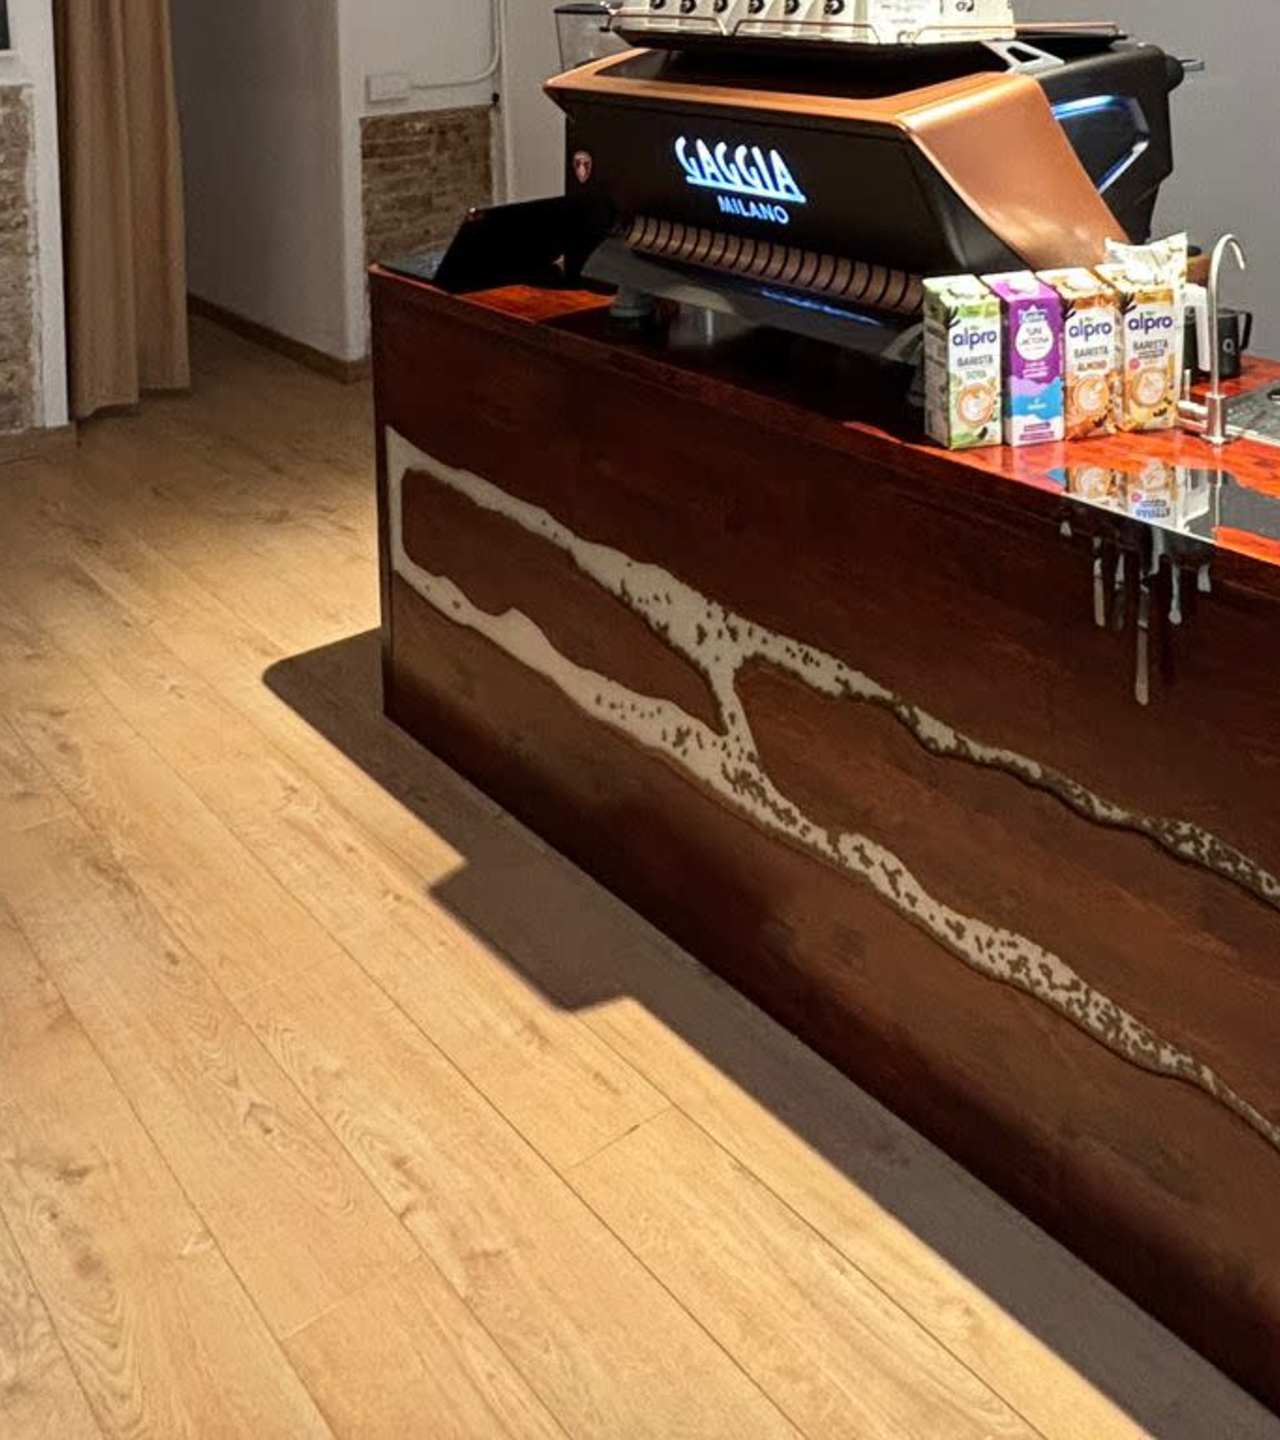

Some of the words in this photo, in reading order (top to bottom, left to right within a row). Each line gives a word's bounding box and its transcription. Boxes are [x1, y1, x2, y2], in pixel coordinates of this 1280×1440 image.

[674, 136, 807, 203] GAGGIA
[717, 195, 790, 225] MILANO
[1069, 318, 1112, 342] alpro
[1128, 312, 1173, 335] alpro
[952, 326, 997, 350] alpro
